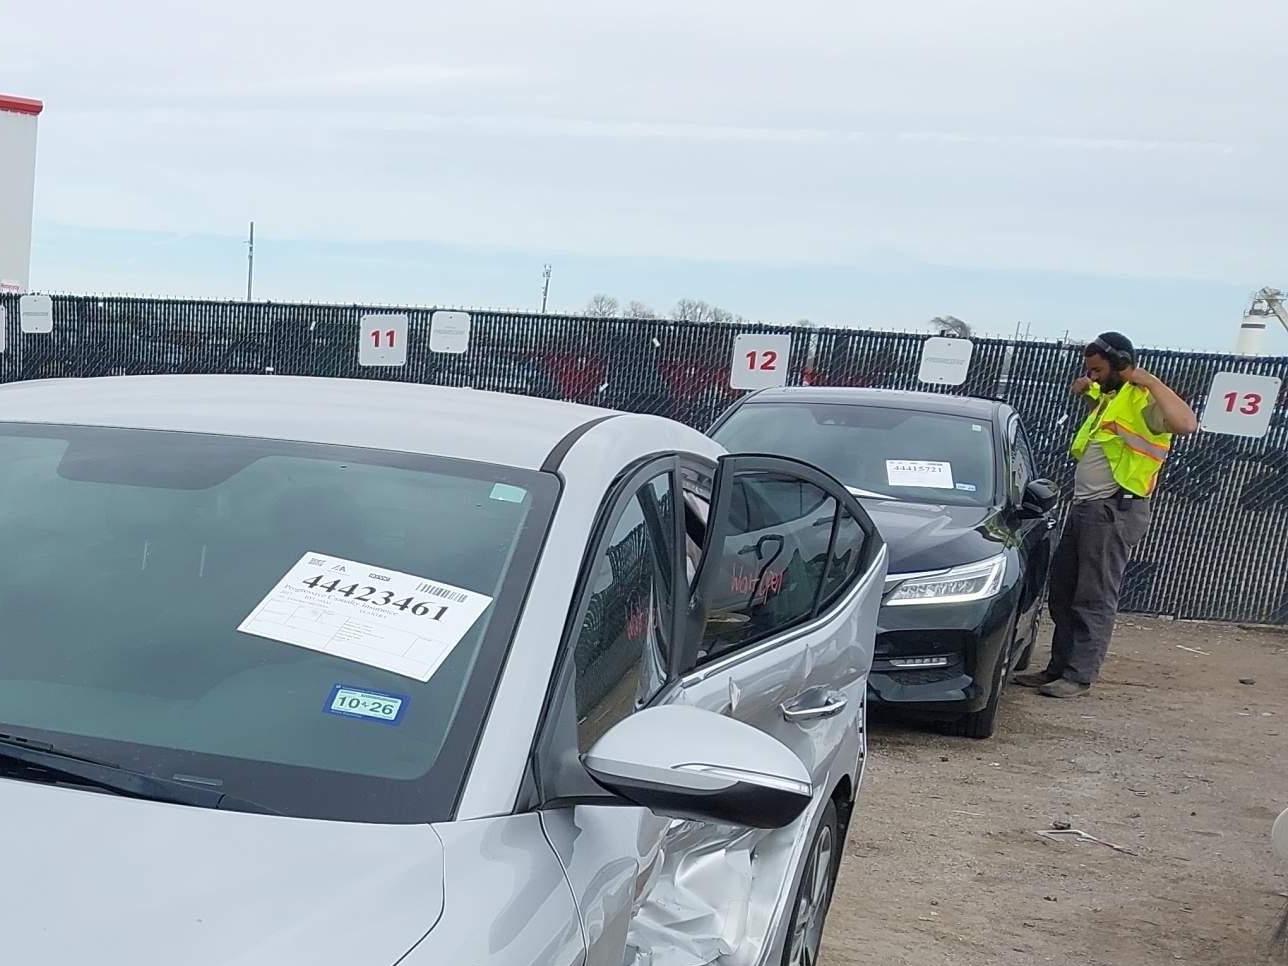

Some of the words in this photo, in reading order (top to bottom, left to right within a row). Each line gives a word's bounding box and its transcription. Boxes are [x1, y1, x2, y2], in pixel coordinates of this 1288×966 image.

[370, 329, 395, 348] 11
[745, 350, 778, 371] 12
[1223, 391, 1262, 416] 13
[302, 574, 449, 622] 44423461
